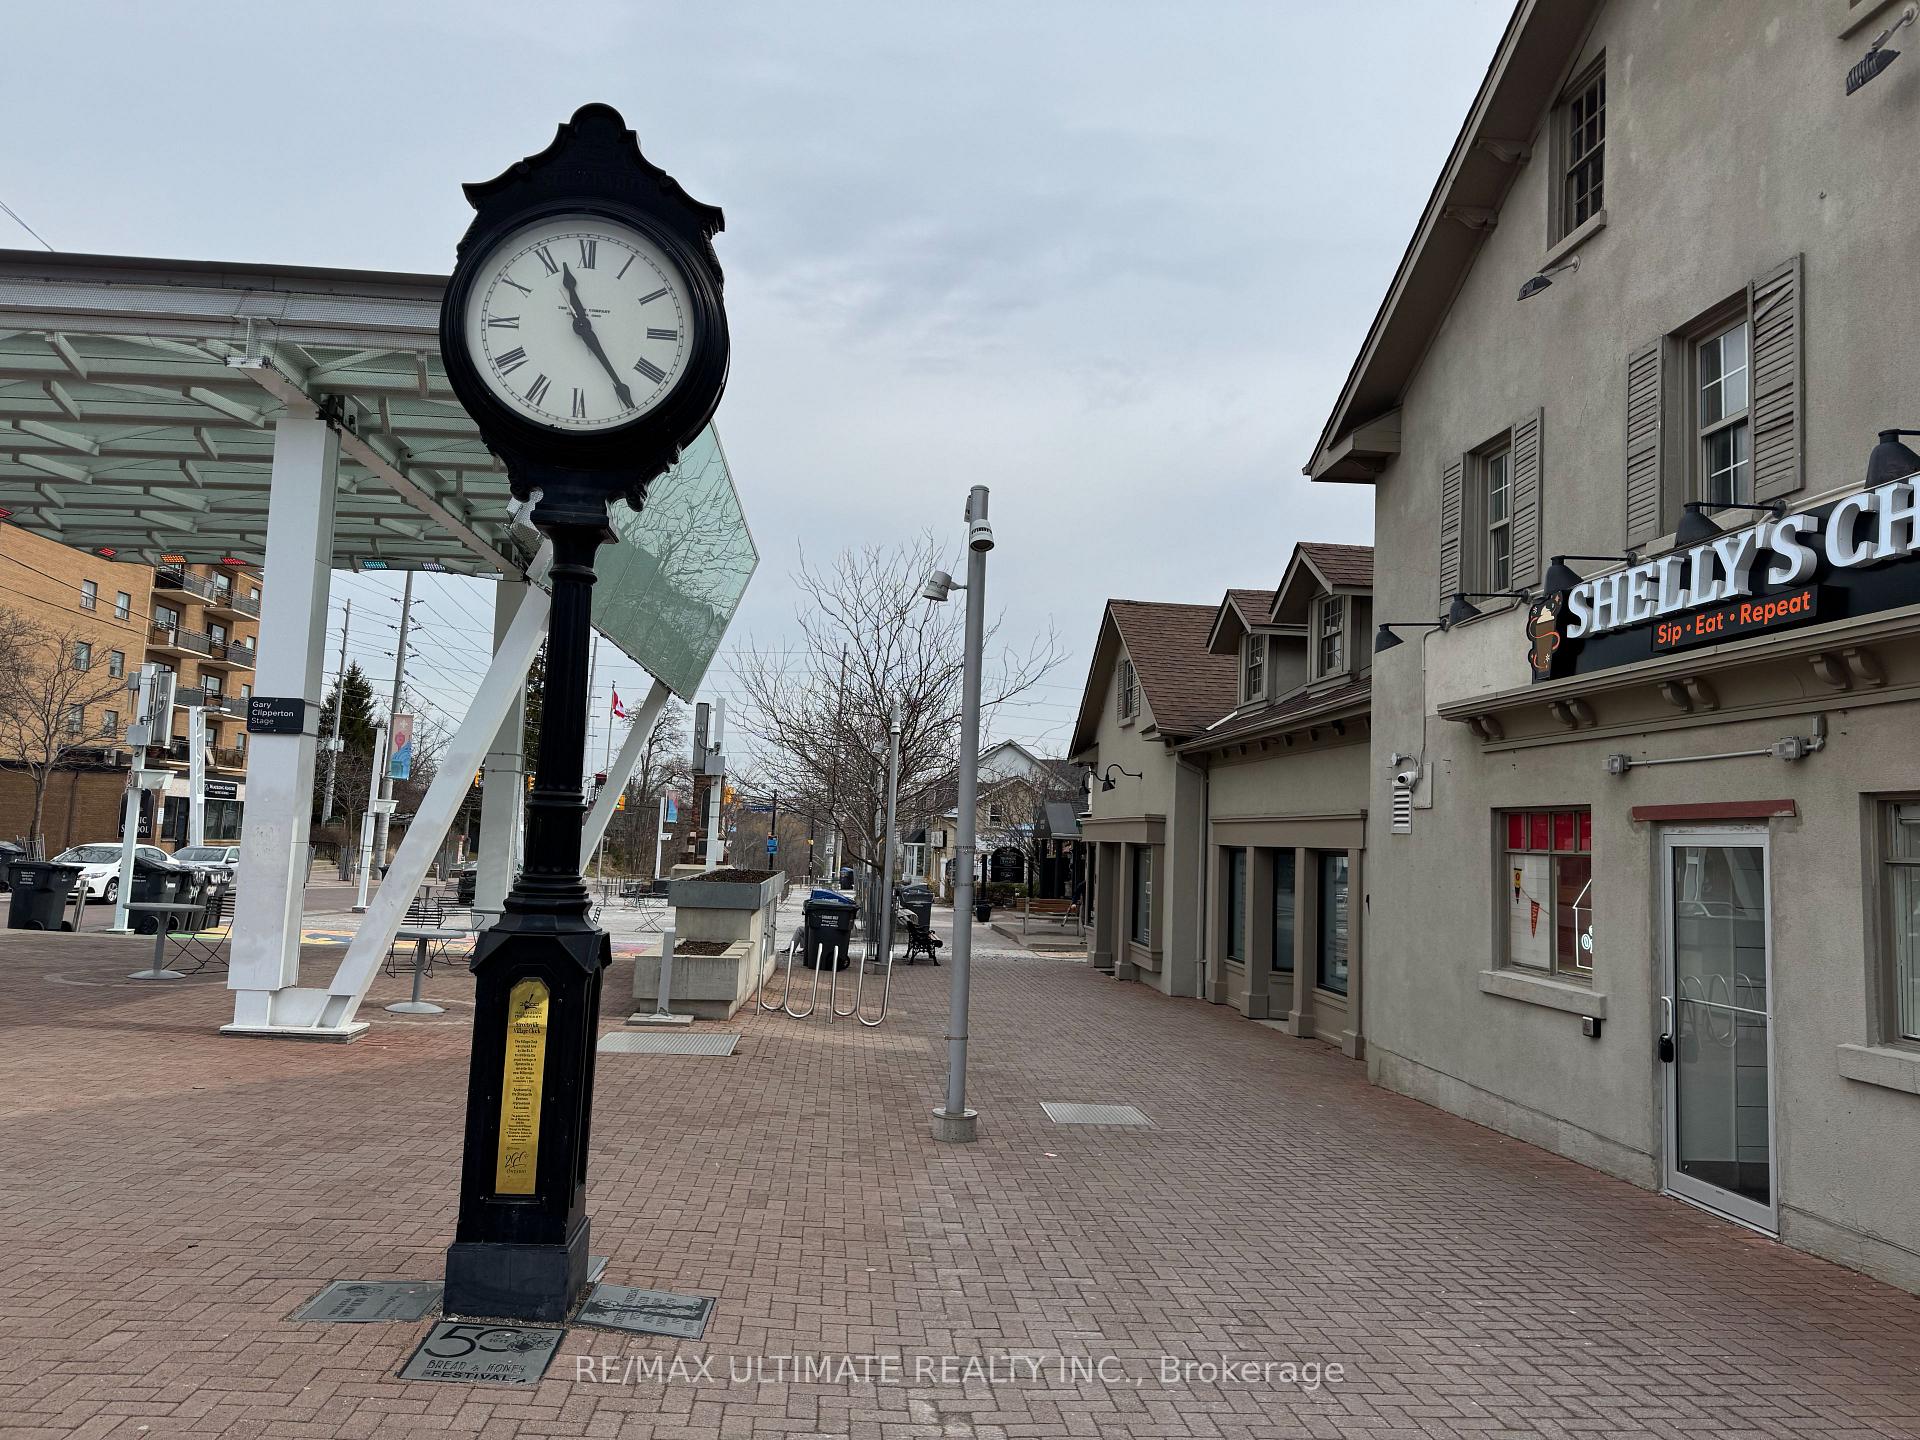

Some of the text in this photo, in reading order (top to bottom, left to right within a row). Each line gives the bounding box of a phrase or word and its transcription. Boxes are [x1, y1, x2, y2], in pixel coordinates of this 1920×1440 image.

[533, 246, 560, 278] XI
[578, 239, 597, 269] XII
[501, 273, 533, 298] X
[638, 287, 669, 305] II
[646, 327, 678, 341] III
[494, 345, 529, 376] VIII
[525, 373, 552, 407] VII
[571, 387, 586, 418] VI
[1567, 514, 1819, 639] SHELLY'S
[1657, 591, 1811, 646] Sip Eat Repeat
[252, 701, 272, 709] Gary
[252, 709, 294, 718] Clipperton
[251, 717, 275, 726] Stage
[427, 1360, 468, 1371] BREAD
[487, 1363, 527, 1373] HONEY
[430, 1371, 510, 1382] FESTIVAL
